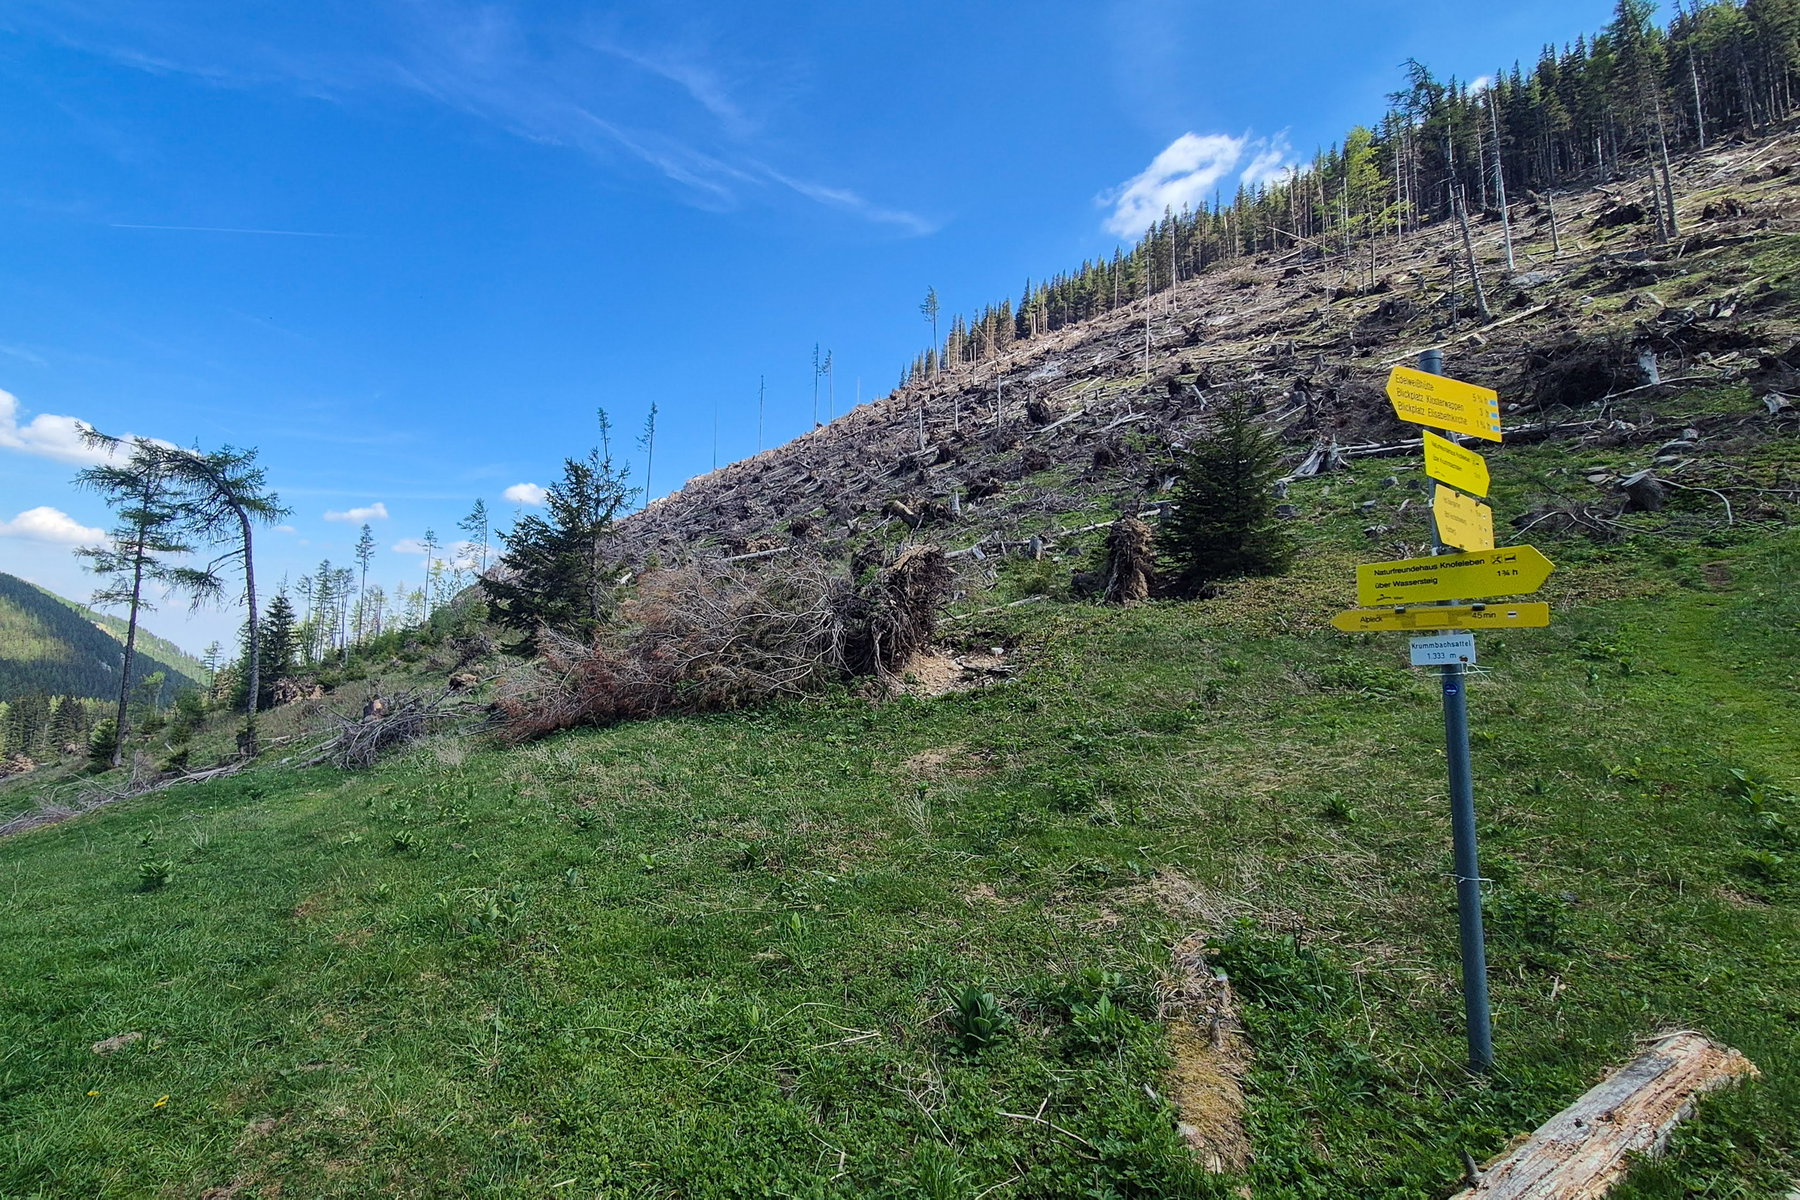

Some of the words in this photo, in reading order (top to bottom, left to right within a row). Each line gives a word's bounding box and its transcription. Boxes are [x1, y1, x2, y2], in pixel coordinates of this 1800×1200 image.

[1396, 387, 1424, 402] Blickplatz
[1398, 400, 1425, 416] Blickplatz
[1374, 564, 1438, 576] Naturfreundehaus
[1440, 559, 1485, 569] Knofeleben
[1392, 577, 1438, 587] Wassersteig
[1411, 640, 1471, 650] Krummbachsattel
